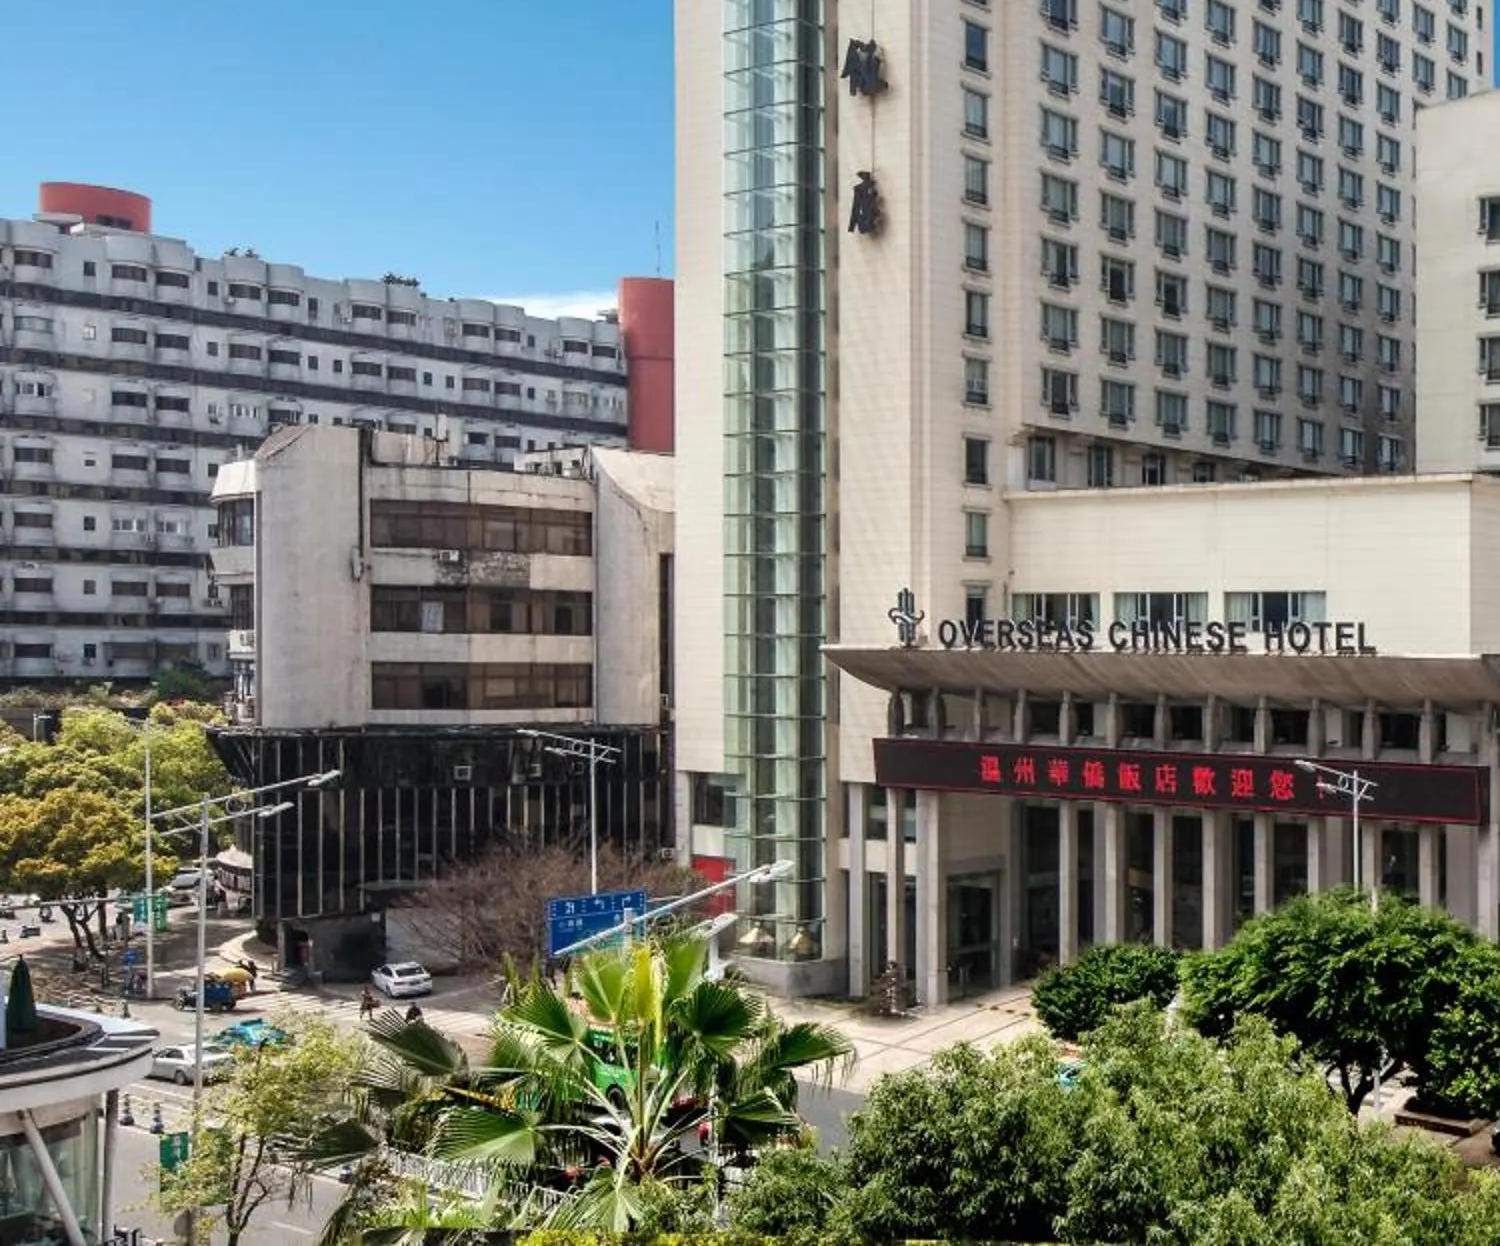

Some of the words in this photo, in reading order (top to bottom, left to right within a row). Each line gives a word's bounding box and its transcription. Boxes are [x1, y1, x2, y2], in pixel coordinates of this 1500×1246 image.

[938, 619, 1095, 652] OVERSEAS
[1108, 620, 1247, 653] CHINESE
[1263, 621, 1377, 655] HOTEL
